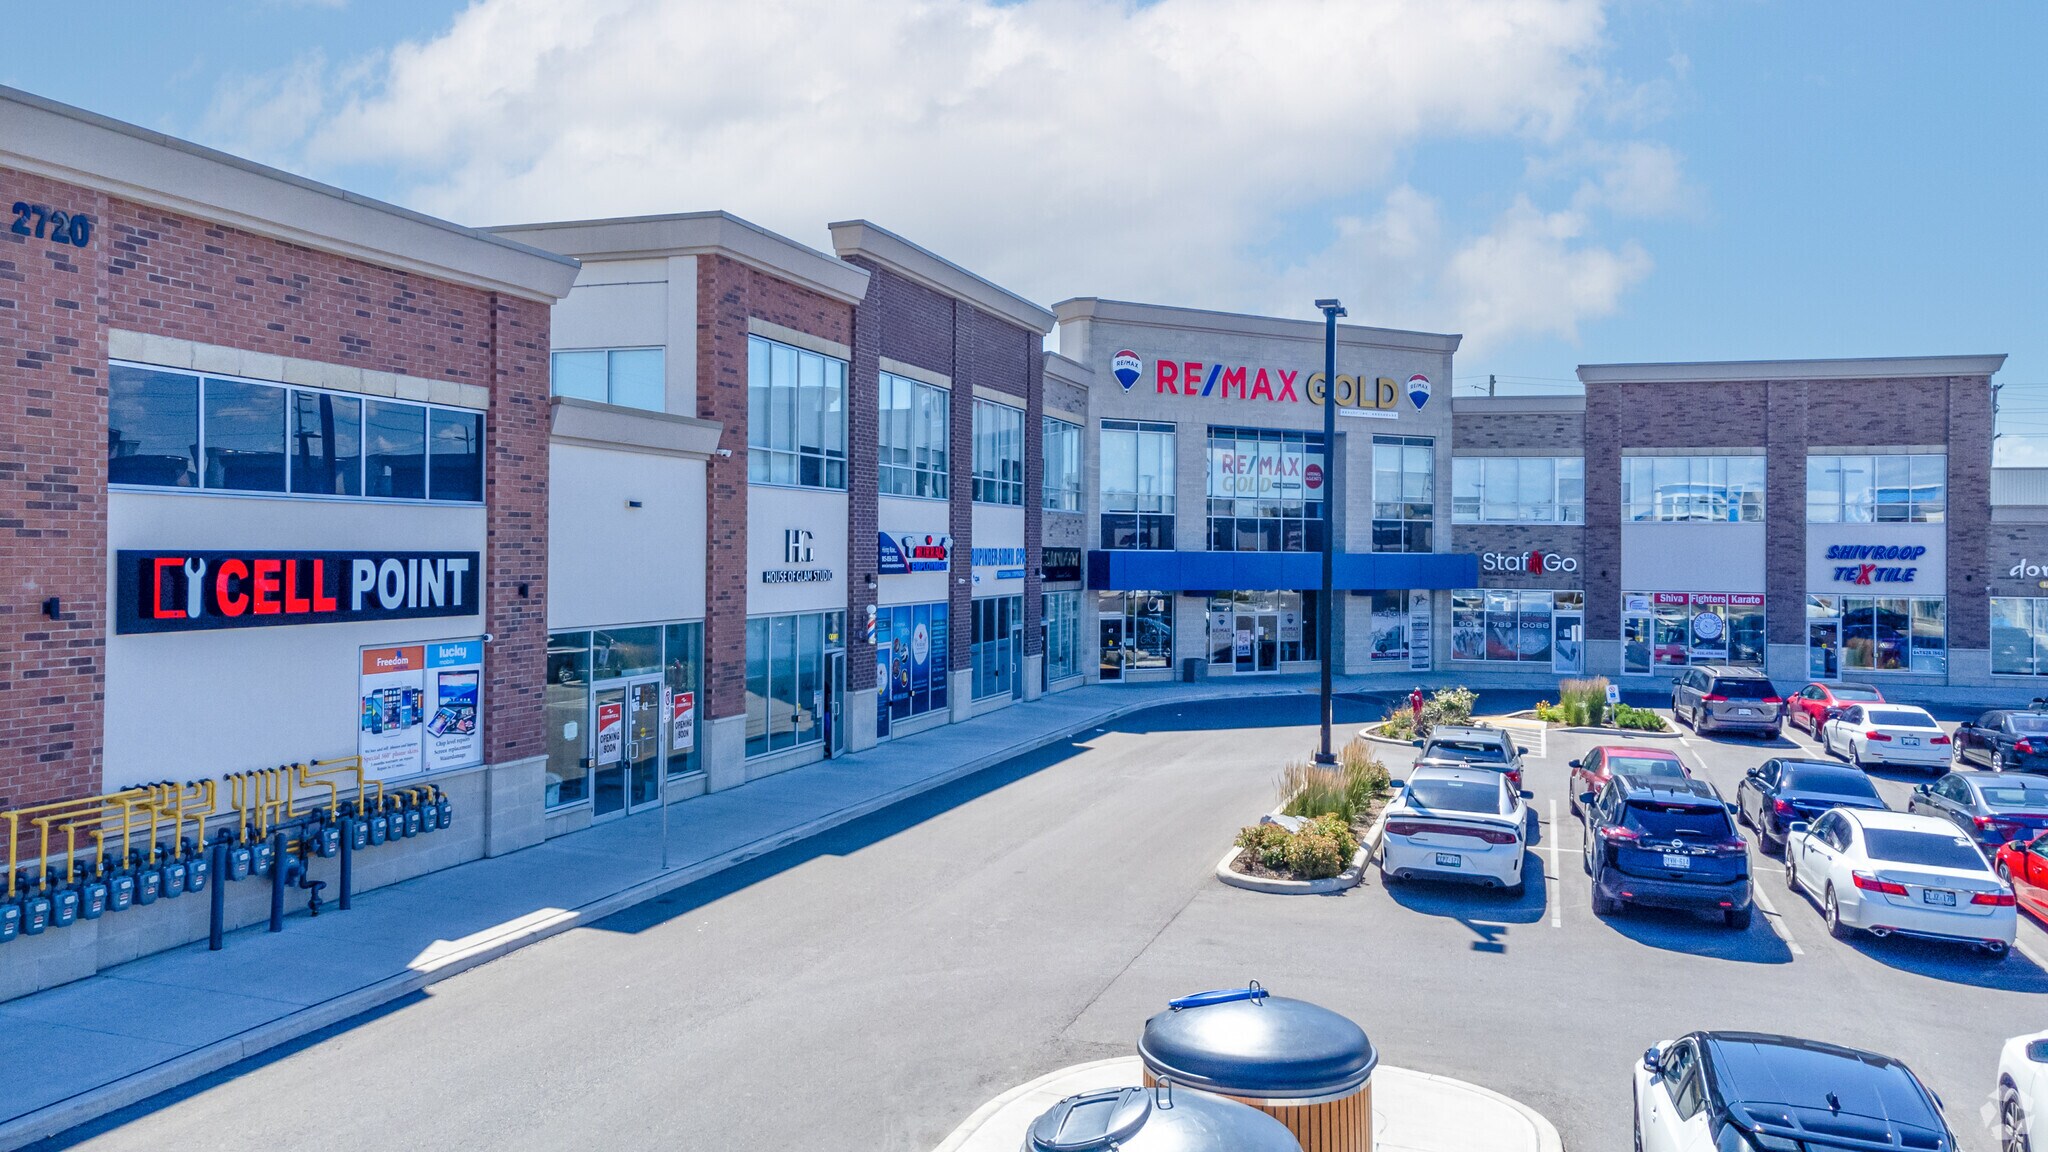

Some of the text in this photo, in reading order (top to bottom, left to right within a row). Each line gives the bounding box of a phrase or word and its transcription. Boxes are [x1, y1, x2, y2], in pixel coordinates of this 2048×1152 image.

[12, 201, 89, 248] 2720
[1116, 360, 1139, 368] RE/MAX
[1155, 360, 1399, 410] RE/MAX GOLD
[1222, 453, 1300, 477] RE/MAX
[1222, 476, 1272, 493] GOLD
[786, 530, 814, 562] HG
[1826, 545, 1926, 560] SHIVROOP
[911, 562, 948, 571] EMPLOYMENT
[1543, 553, 1577, 572] Go
[765, 570, 832, 583] HOUSE OF GLAM STUDIO
[1834, 563, 1918, 585] TEXTILE
[216, 558, 469, 617] CELL POINT
[1660, 594, 1684, 602] Shiva
[1691, 594, 1726, 604] Fighters
[1731, 595, 1760, 604] Karate
[439, 644, 467, 659] lucky
[377, 656, 409, 666] Freedom
[675, 719, 692, 730] OPENING
[600, 731, 620, 744] OPENING
[678, 729, 689, 739] SOON
[603, 743, 616, 753] SOON
